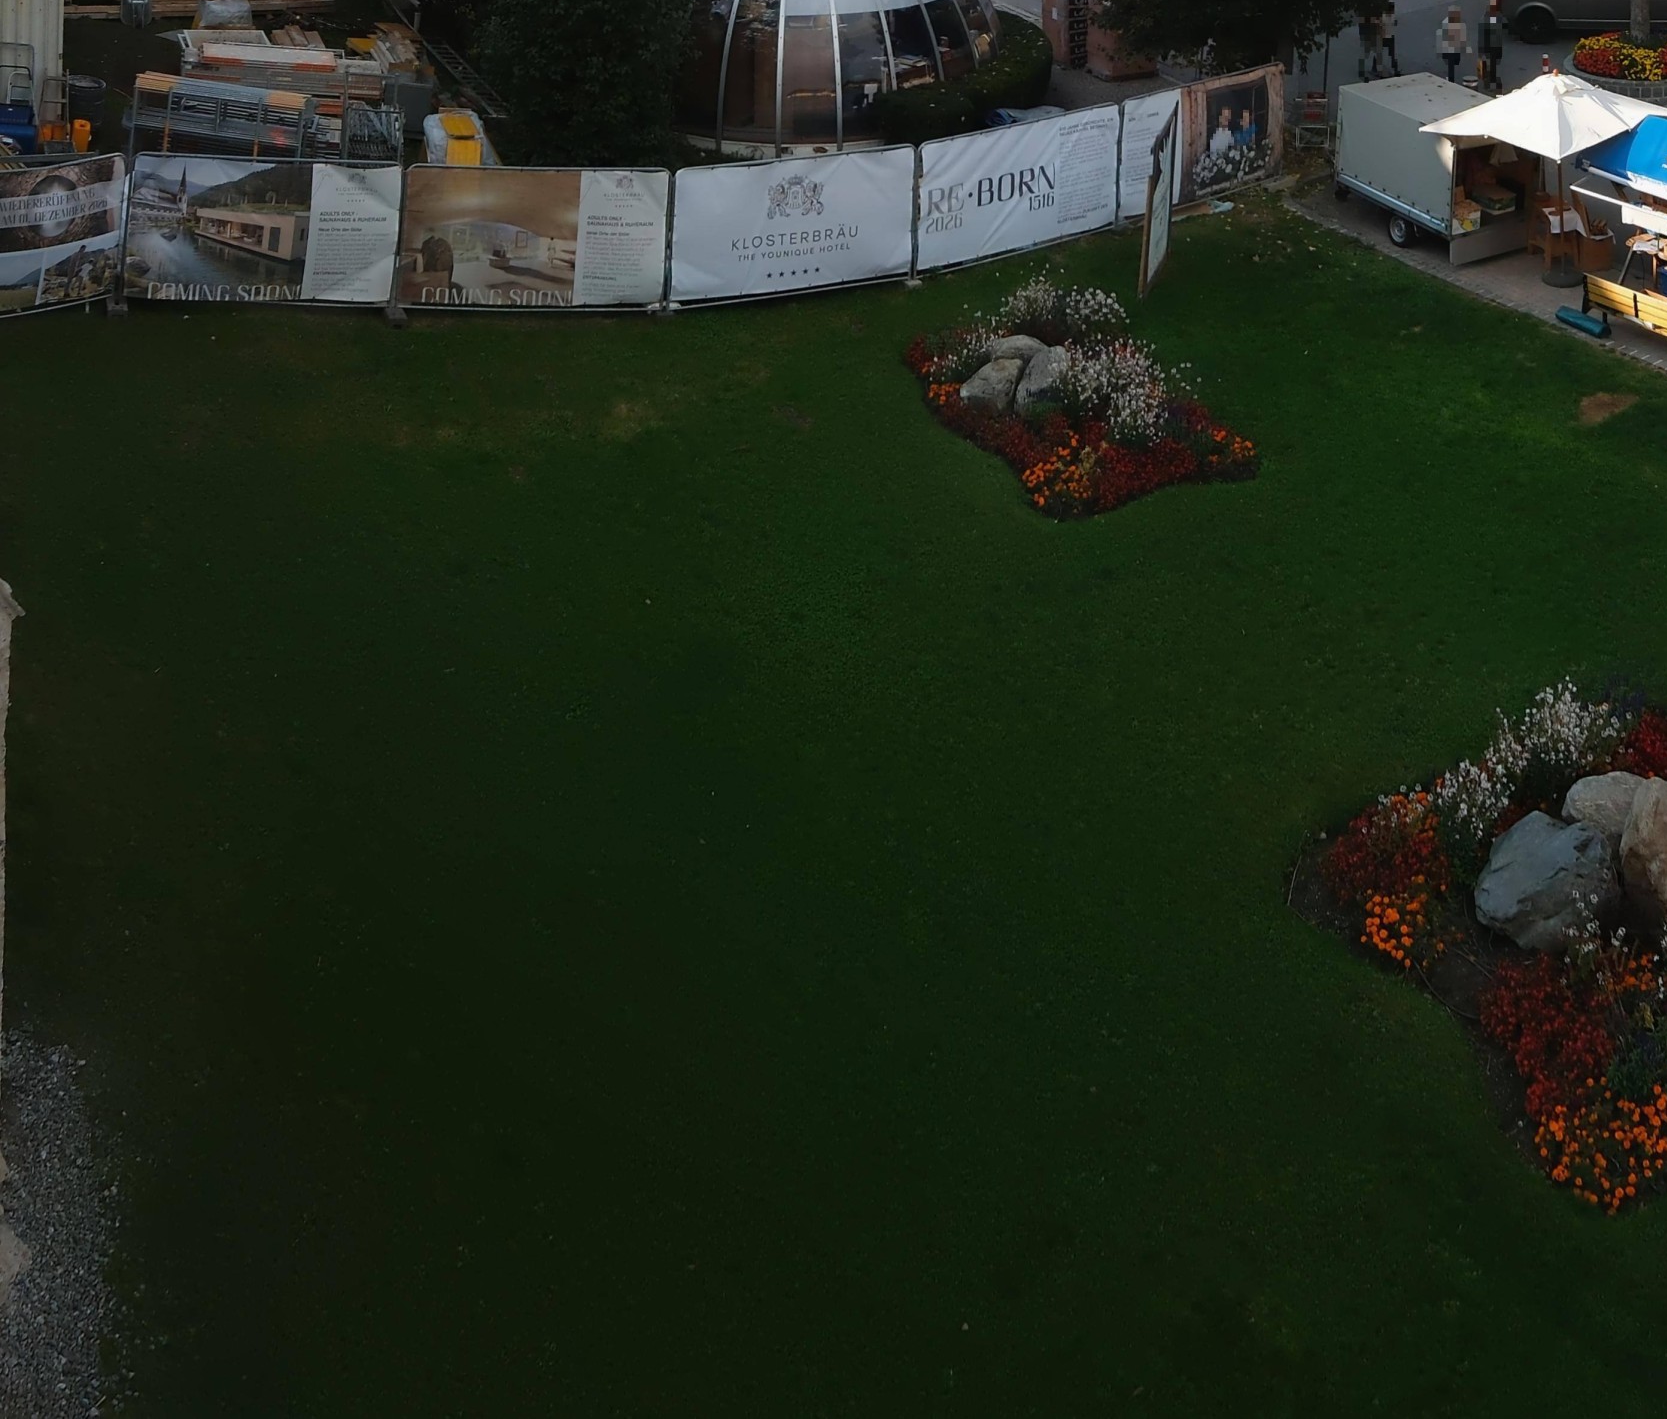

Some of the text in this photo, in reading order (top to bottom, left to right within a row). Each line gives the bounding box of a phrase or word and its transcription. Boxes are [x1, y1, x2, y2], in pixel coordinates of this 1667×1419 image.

[1028, 192, 1056, 213] 1516
[926, 212, 963, 235] 2026
[731, 224, 859, 252] KLOSTERBRÄU
[738, 243, 850, 262] THE YOUNIQUE HOTEL
